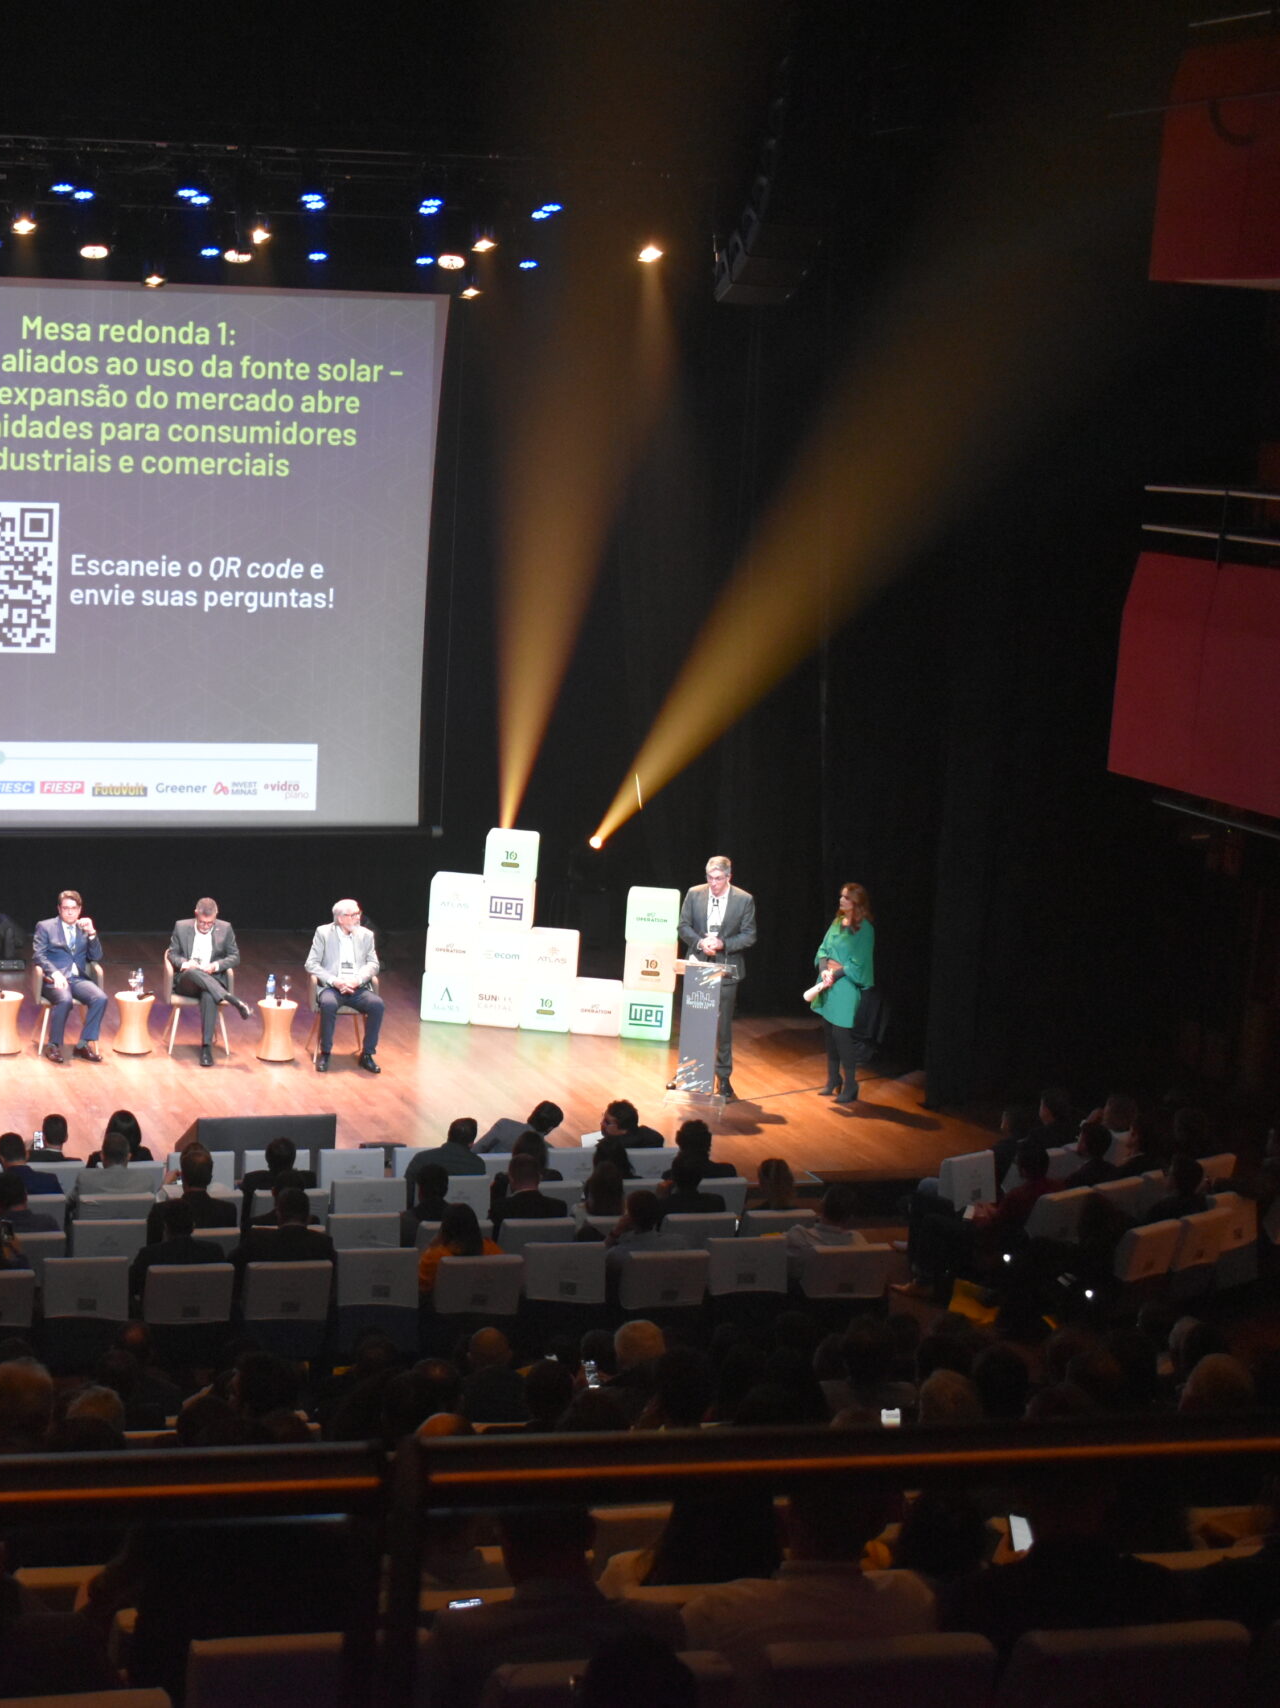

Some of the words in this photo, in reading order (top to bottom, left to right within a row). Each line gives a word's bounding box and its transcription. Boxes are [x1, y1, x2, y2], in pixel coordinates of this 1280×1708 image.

[21, 314, 92, 342] Mesa
[98, 318, 211, 346] redonda
[217, 321, 236, 346] 1:
[1, 347, 100, 375] aliados
[105, 356, 139, 376] ao
[145, 357, 194, 378] uso
[200, 353, 234, 379] da
[239, 354, 311, 381] fonte
[317, 357, 385, 383] solar
[135, 384, 169, 410] do
[175, 388, 294, 413] mercado
[300, 389, 361, 415] abre
[100, 421, 161, 446] para
[167, 420, 357, 447] consumidores
[118, 454, 135, 474] e
[140, 452, 290, 478] comerciais
[70, 553, 182, 578] Escaneie
[187, 560, 203, 578] o
[208, 556, 242, 582] QR
[246, 557, 305, 580] code
[309, 562, 325, 580] e
[69, 583, 136, 606] envie
[141, 589, 198, 607] suas
[203, 587, 334, 614] perguntas!
[42, 782, 83, 793] FIESP
[155, 782, 208, 793] Greener
[270, 780, 300, 792] vidro
[494, 951, 520, 961] ecom
